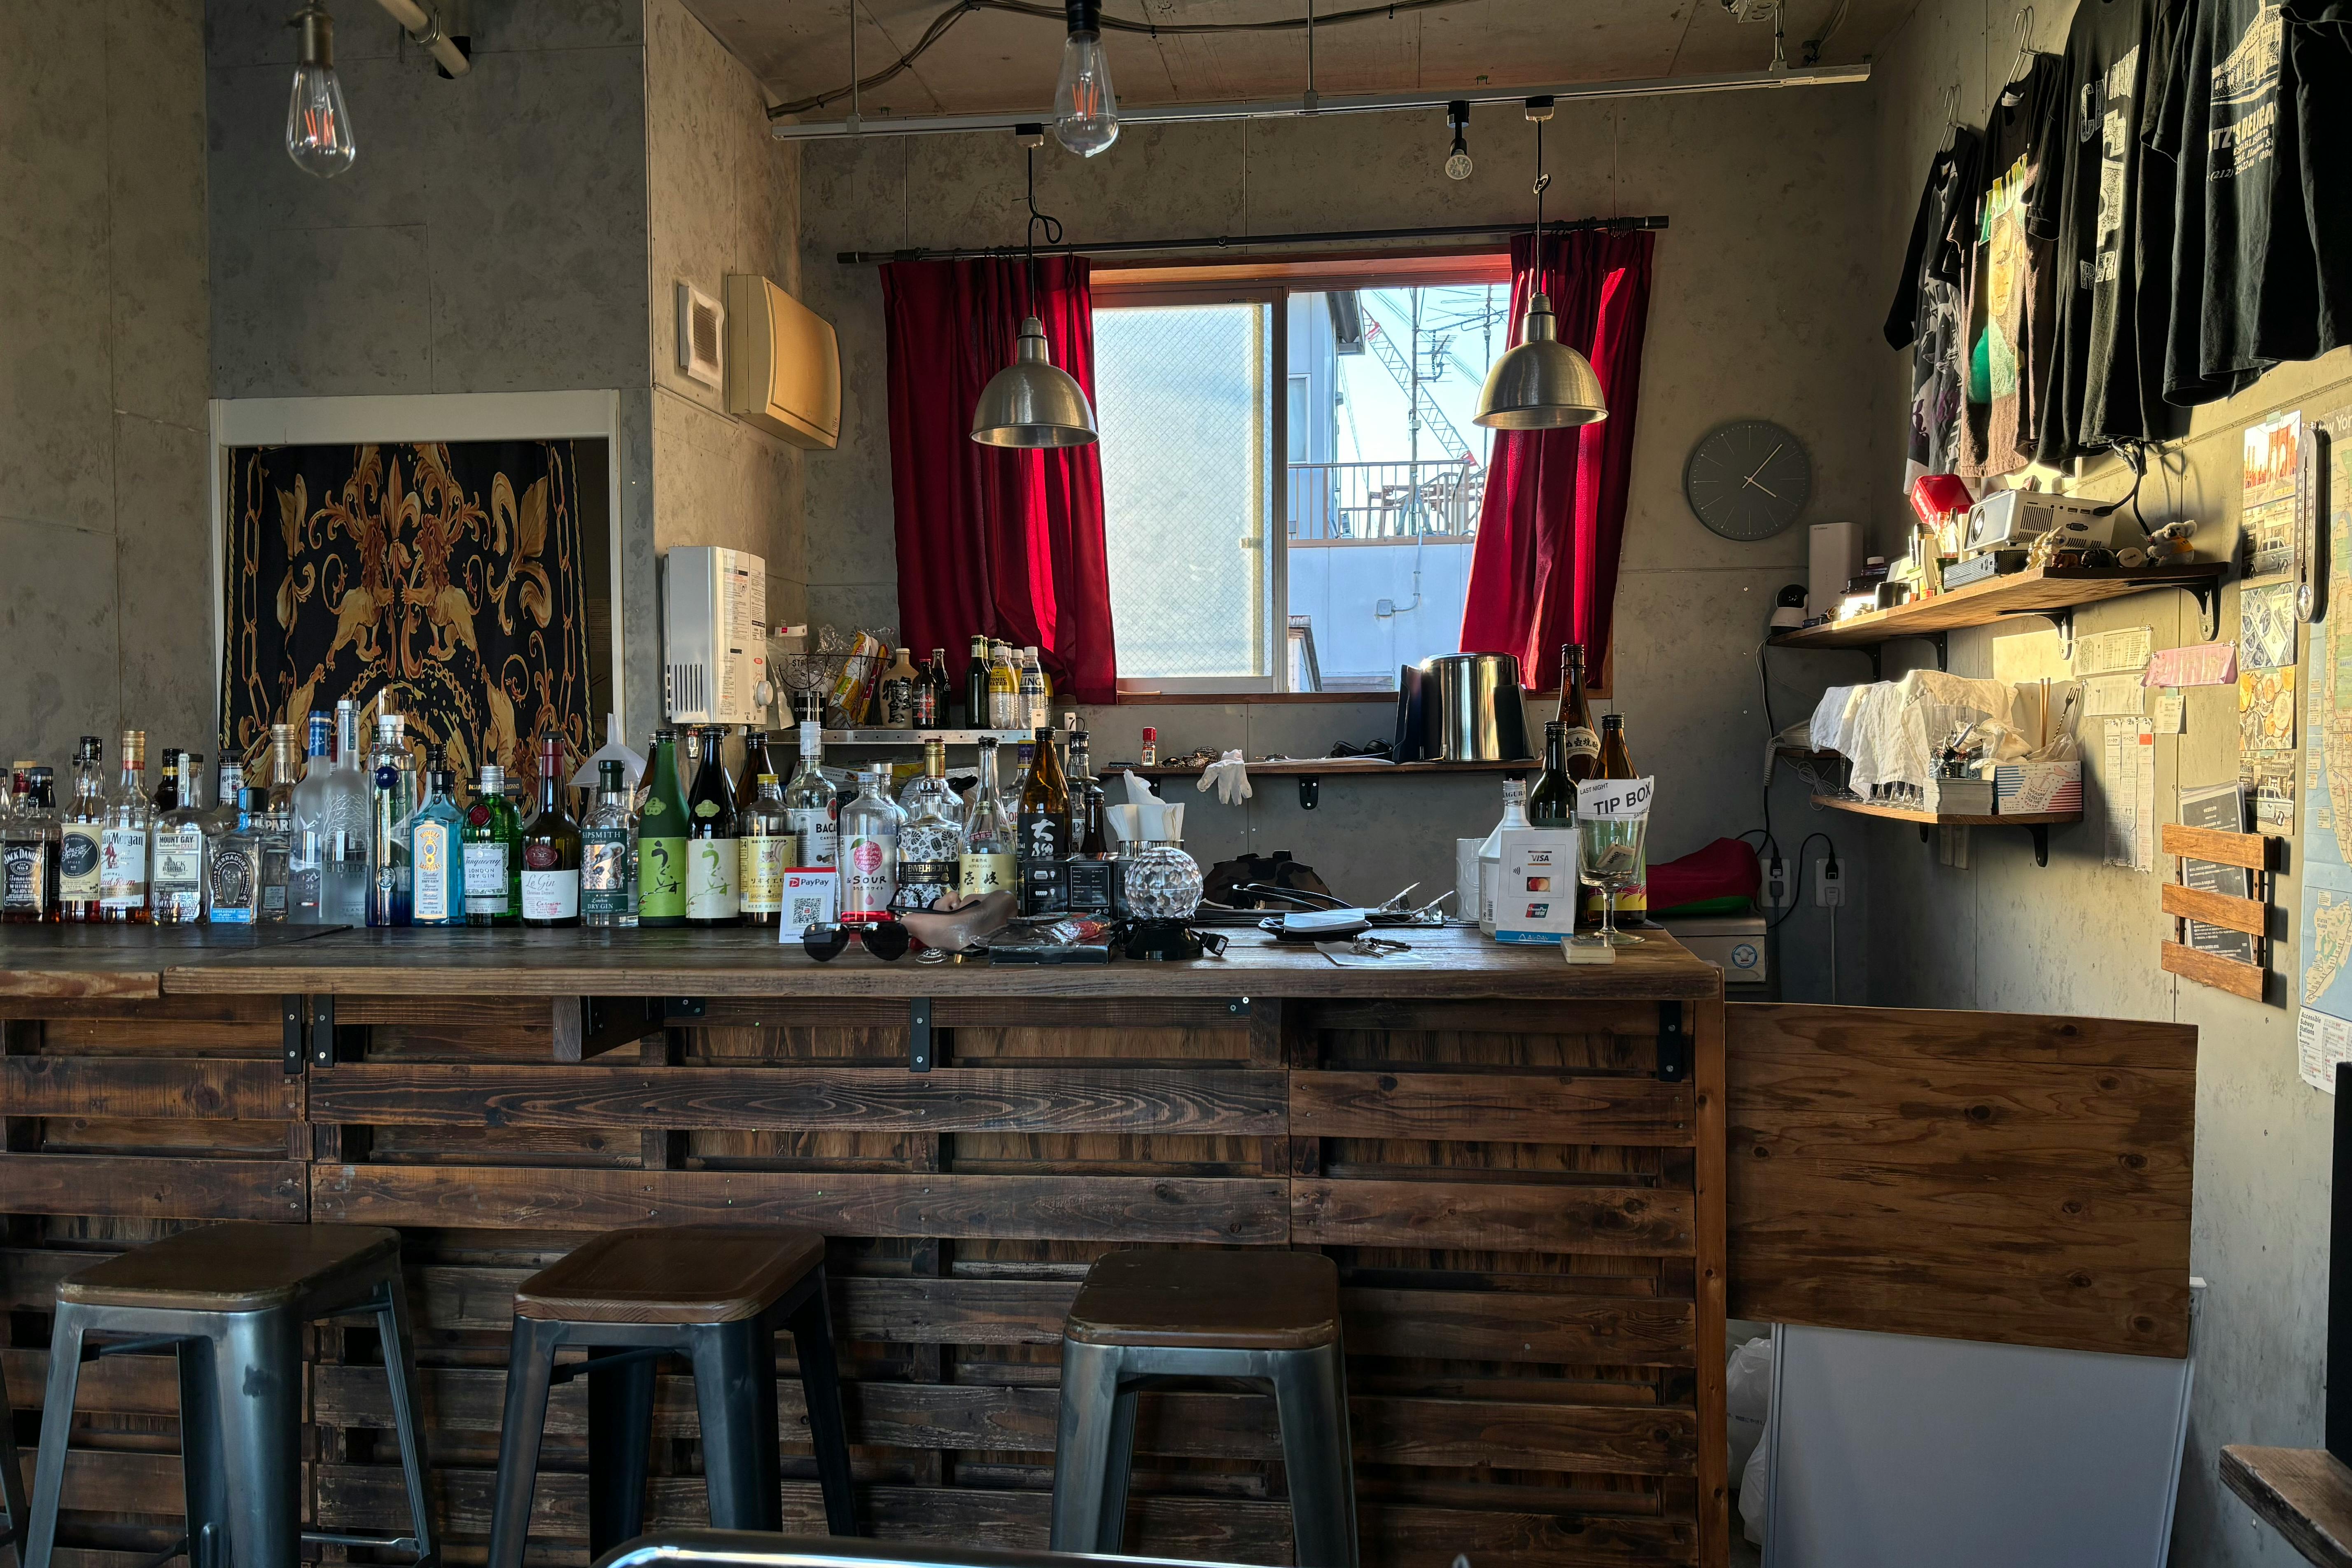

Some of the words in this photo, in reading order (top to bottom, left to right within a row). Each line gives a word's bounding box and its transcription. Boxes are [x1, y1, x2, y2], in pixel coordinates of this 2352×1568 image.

[2210, 169, 2233, 181] (212)
[1580, 786, 1592, 795] LAST
[1593, 783, 1608, 791] NIGHT
[1594, 797, 1620, 815] TIP
[1626, 781, 1651, 807] BOX
[112, 832, 143, 846] Morgan
[4, 851, 19, 864] JACK
[215, 855, 248, 871] HERRADURA
[466, 856, 501, 866] Tanqueray
[908, 864, 949, 873] ENVELHECIDA
[526, 874, 536, 889] Le
[537, 874, 556, 891] Gin
[853, 876, 887, 884] SOUR
[2300, 1018, 2314, 1029] Subway
[2301, 1012, 2321, 1023] Accessible
[2299, 1025, 2315, 1036] Stations
